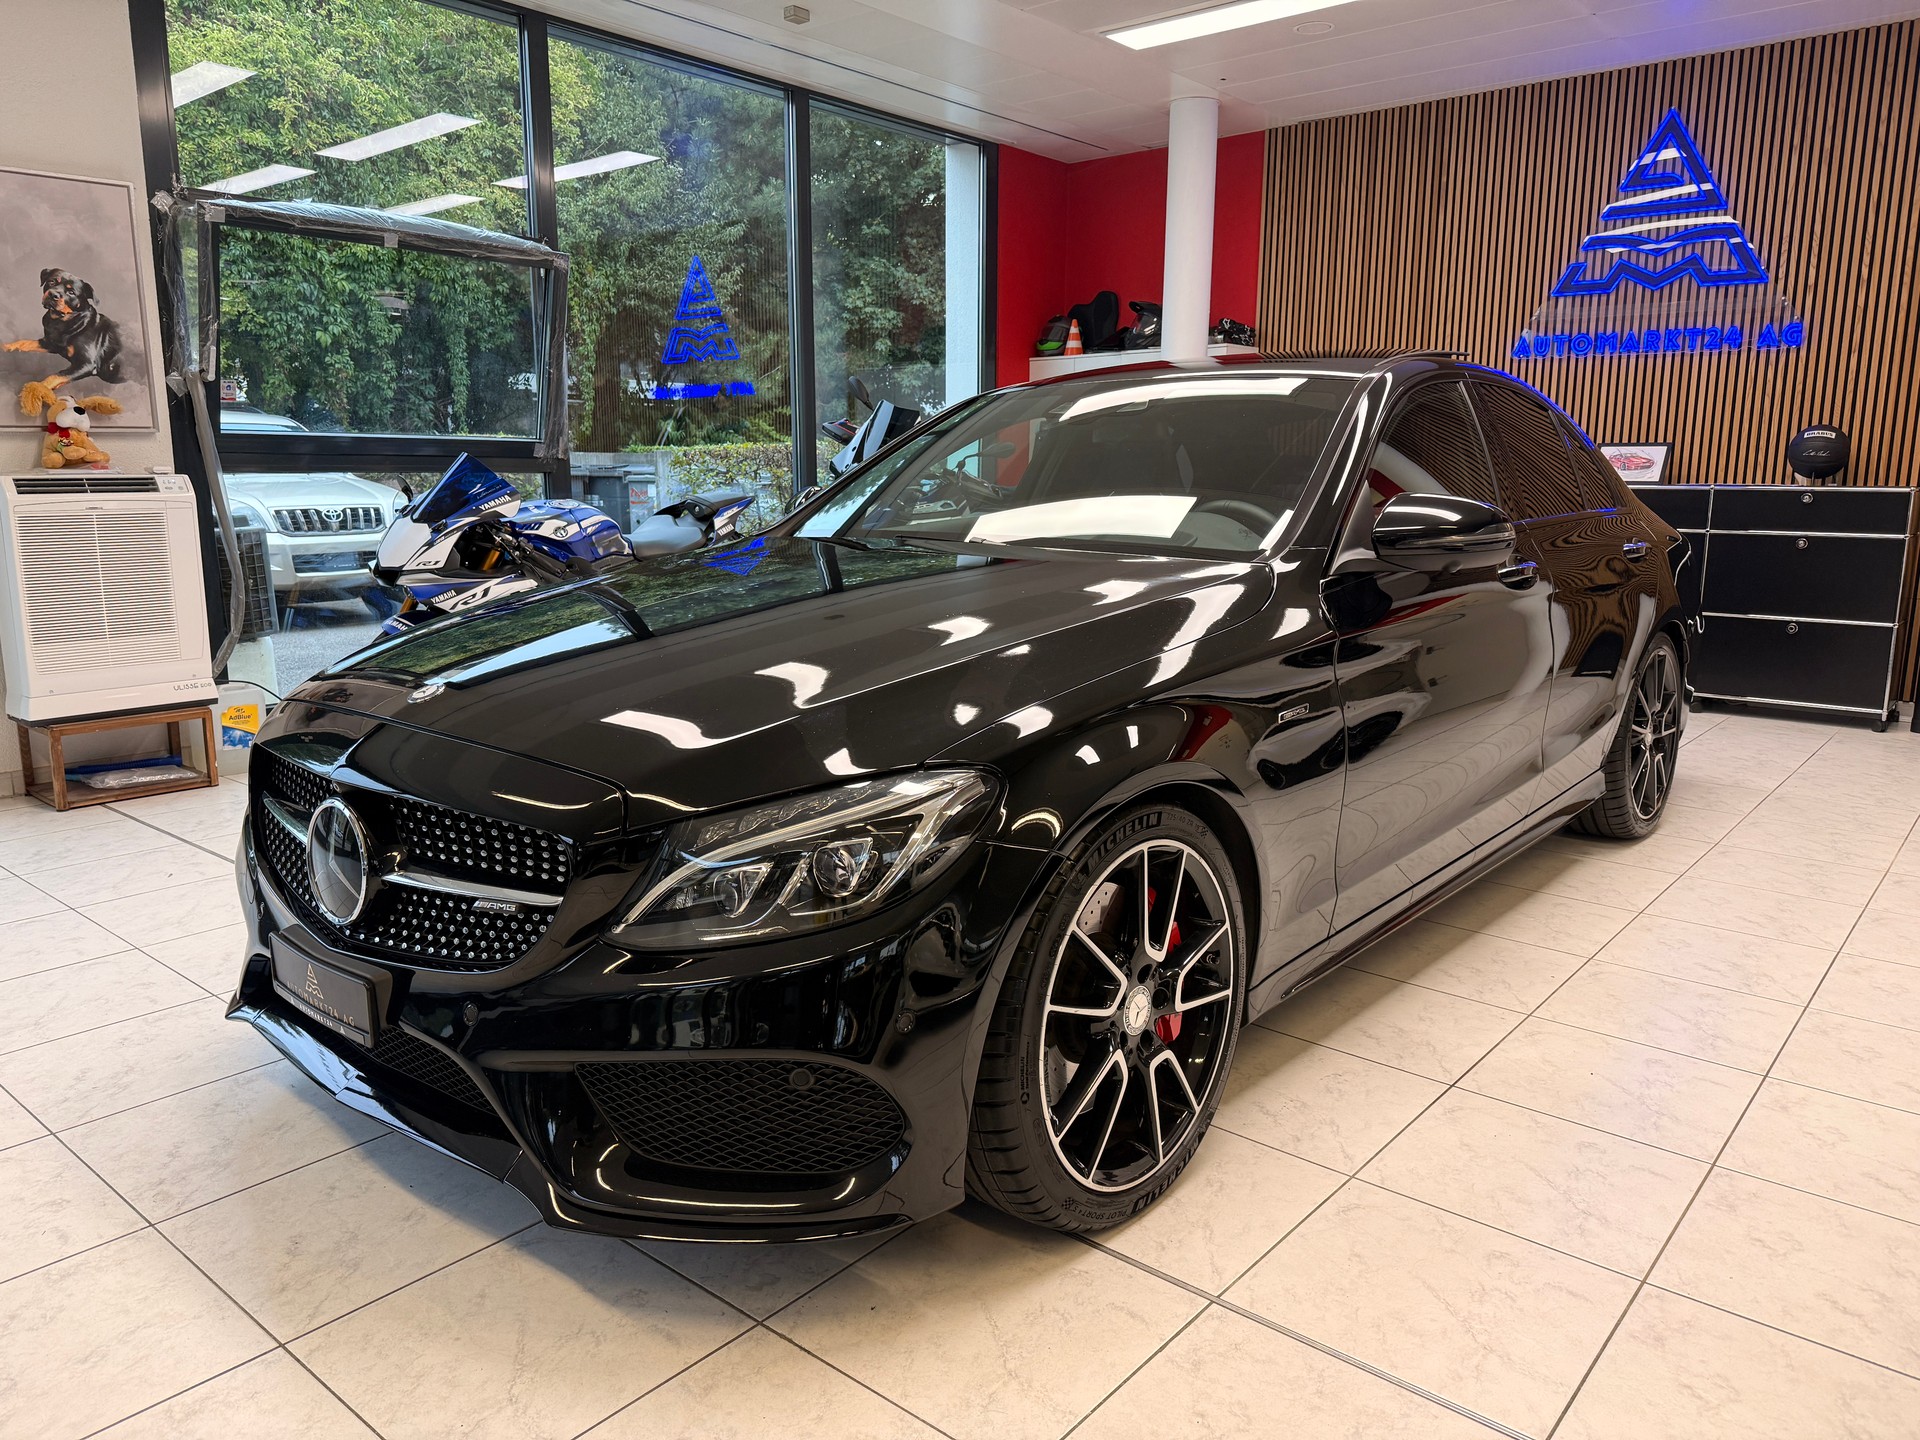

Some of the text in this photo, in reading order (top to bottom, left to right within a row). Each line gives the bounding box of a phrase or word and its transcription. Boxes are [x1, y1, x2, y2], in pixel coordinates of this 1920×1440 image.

[1512, 322, 1804, 358] AUTOMARKT24 AG
[478, 495, 512, 511] YAMAHA
[430, 589, 457, 604] YAMAHA
[1088, 812, 1160, 872] MICHELIN
[486, 902, 516, 911] AMG
[287, 981, 356, 1027] AUTOMARKT24 AG
[1080, 1210, 1105, 1220] SPORT
[1106, 1209, 1128, 1220] PILOT
